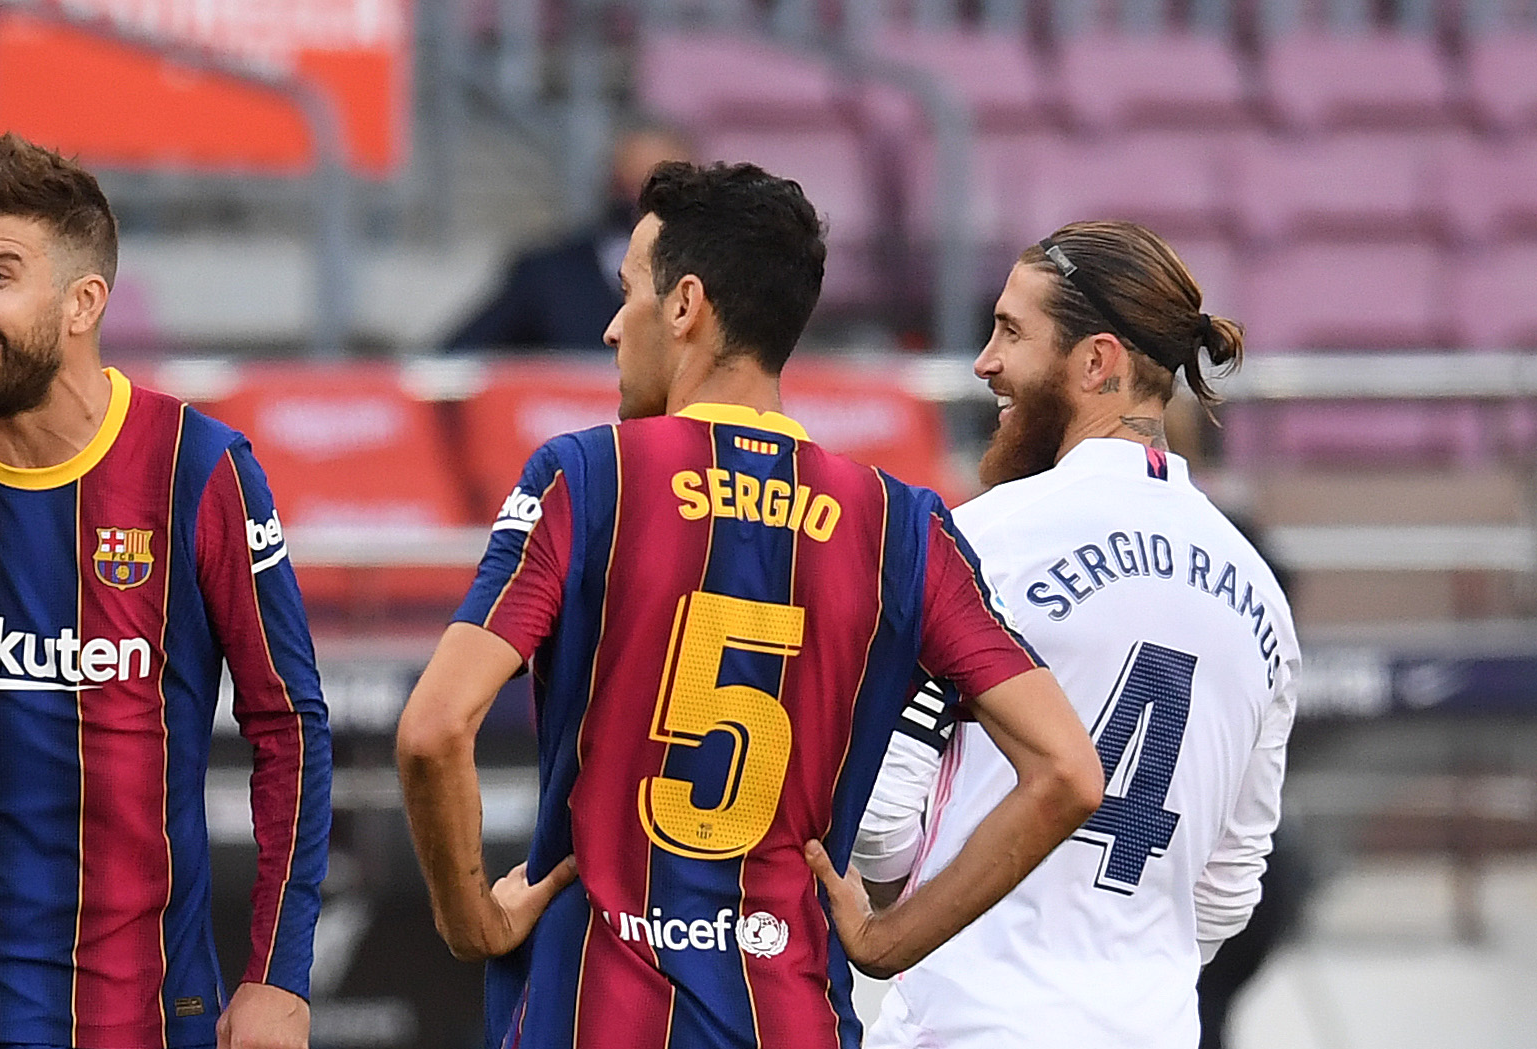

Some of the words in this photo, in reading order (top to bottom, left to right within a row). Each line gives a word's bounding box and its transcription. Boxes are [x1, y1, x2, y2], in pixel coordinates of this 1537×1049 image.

[671, 468, 841, 542] SERGIO
[1025, 531, 1174, 622] SERGIO
[638, 591, 805, 860] 5
[1069, 641, 1198, 895] 4
